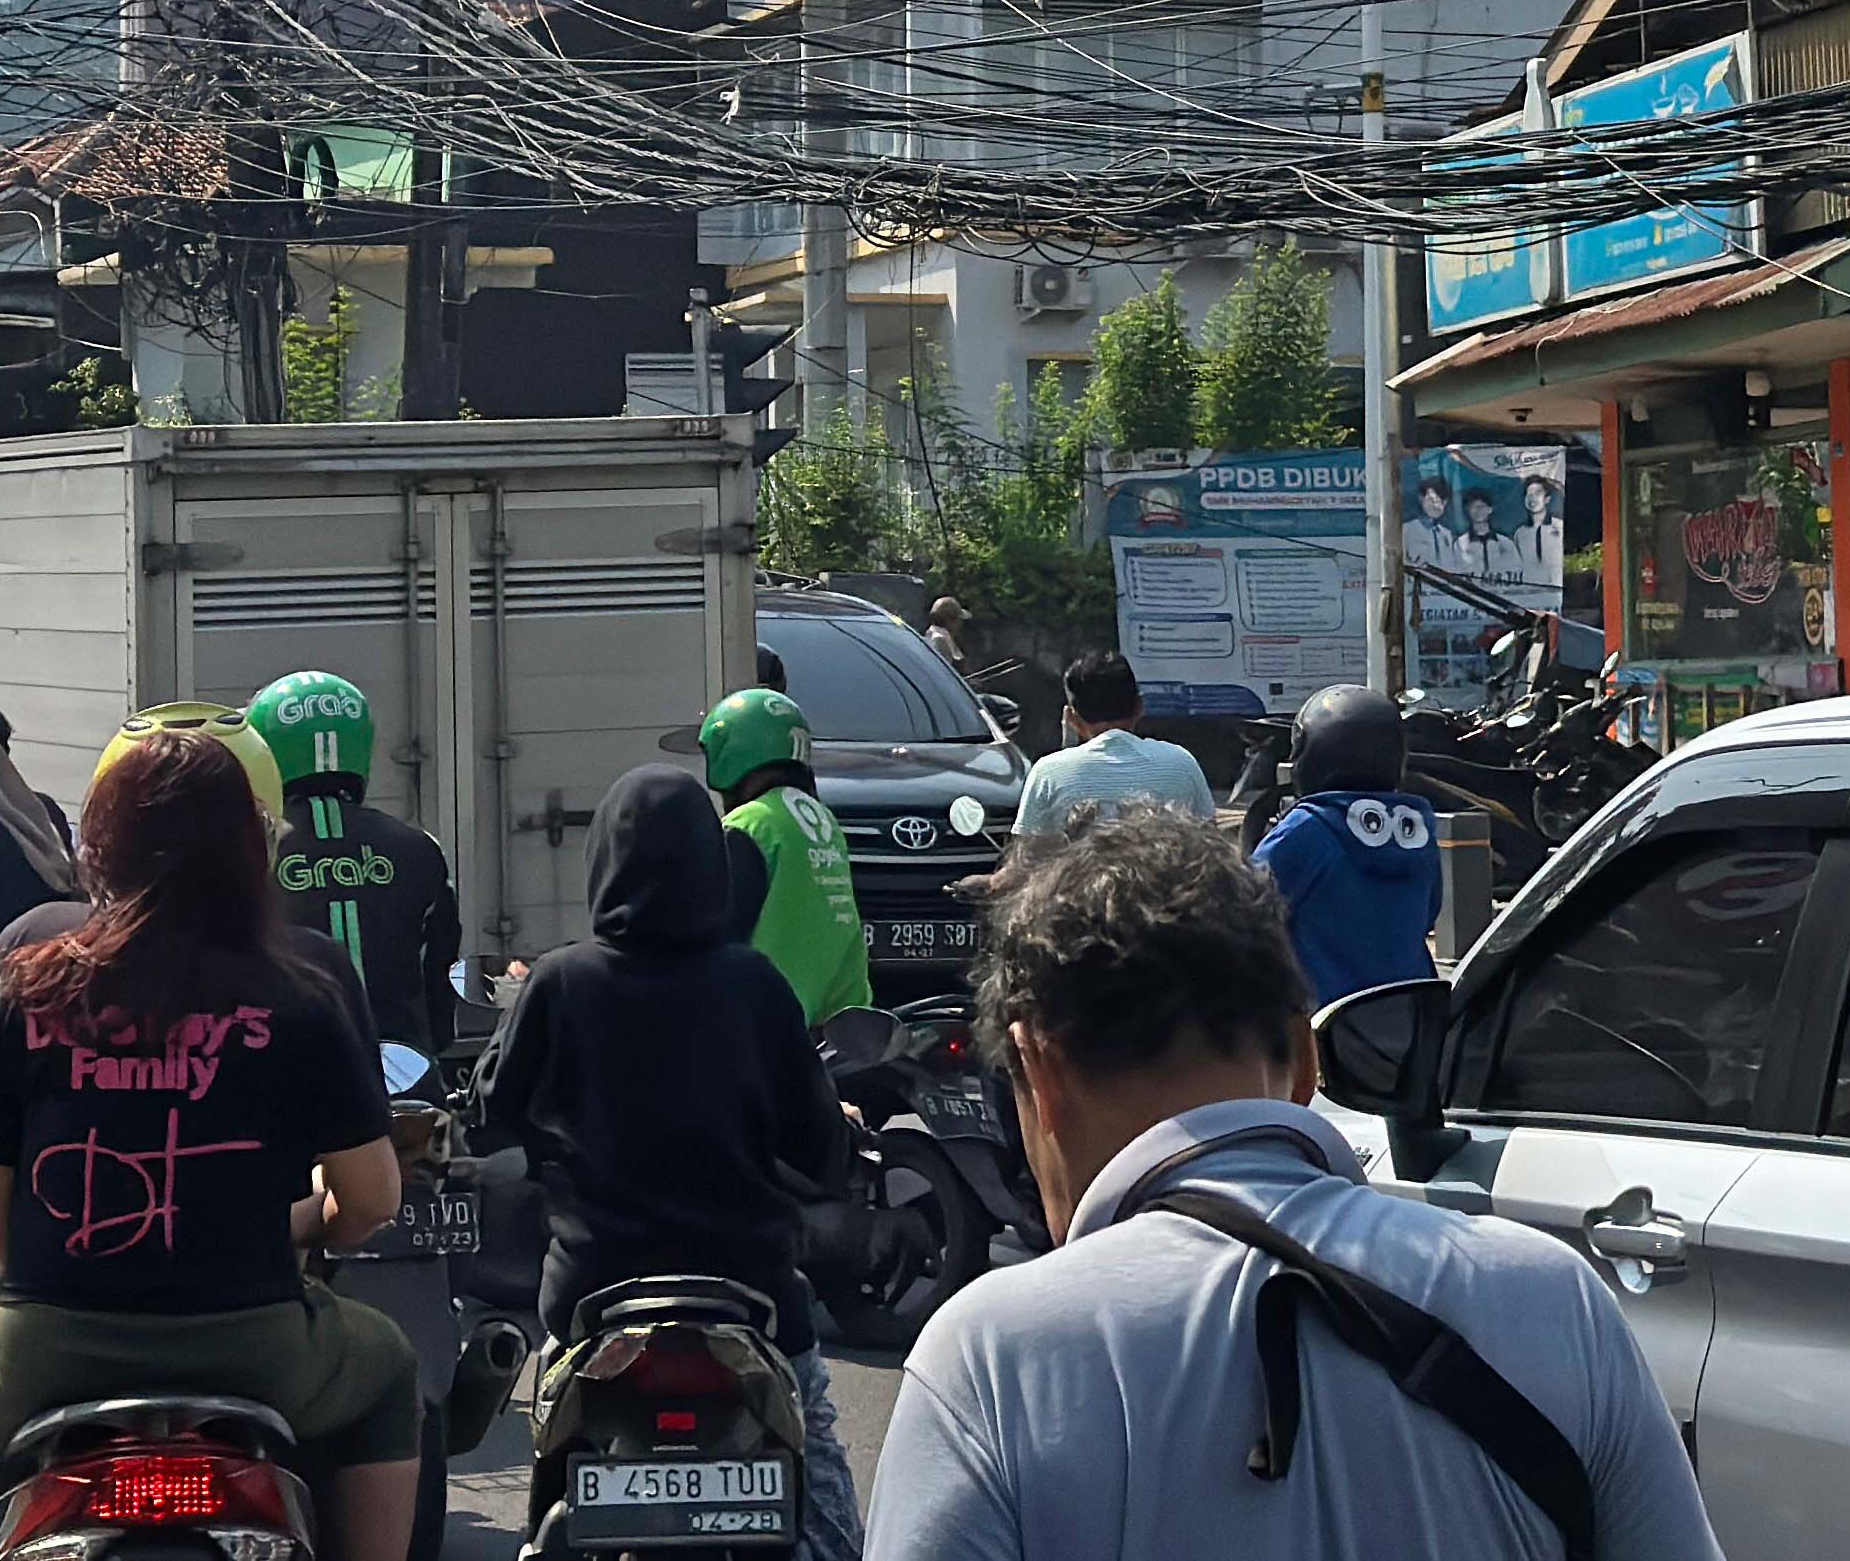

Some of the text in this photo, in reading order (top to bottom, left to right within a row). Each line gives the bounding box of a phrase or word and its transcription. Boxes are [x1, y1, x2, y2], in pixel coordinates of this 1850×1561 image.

[1200, 467, 1366, 488] PPDB DIBUK
[277, 687, 363, 725] Grab
[277, 844, 395, 892] Grab
[863, 923, 875, 947] B
[891, 923, 934, 947] 2959
[70, 1045, 220, 1101] Family
[582, 1465, 777, 1502] B 4568 TUU
